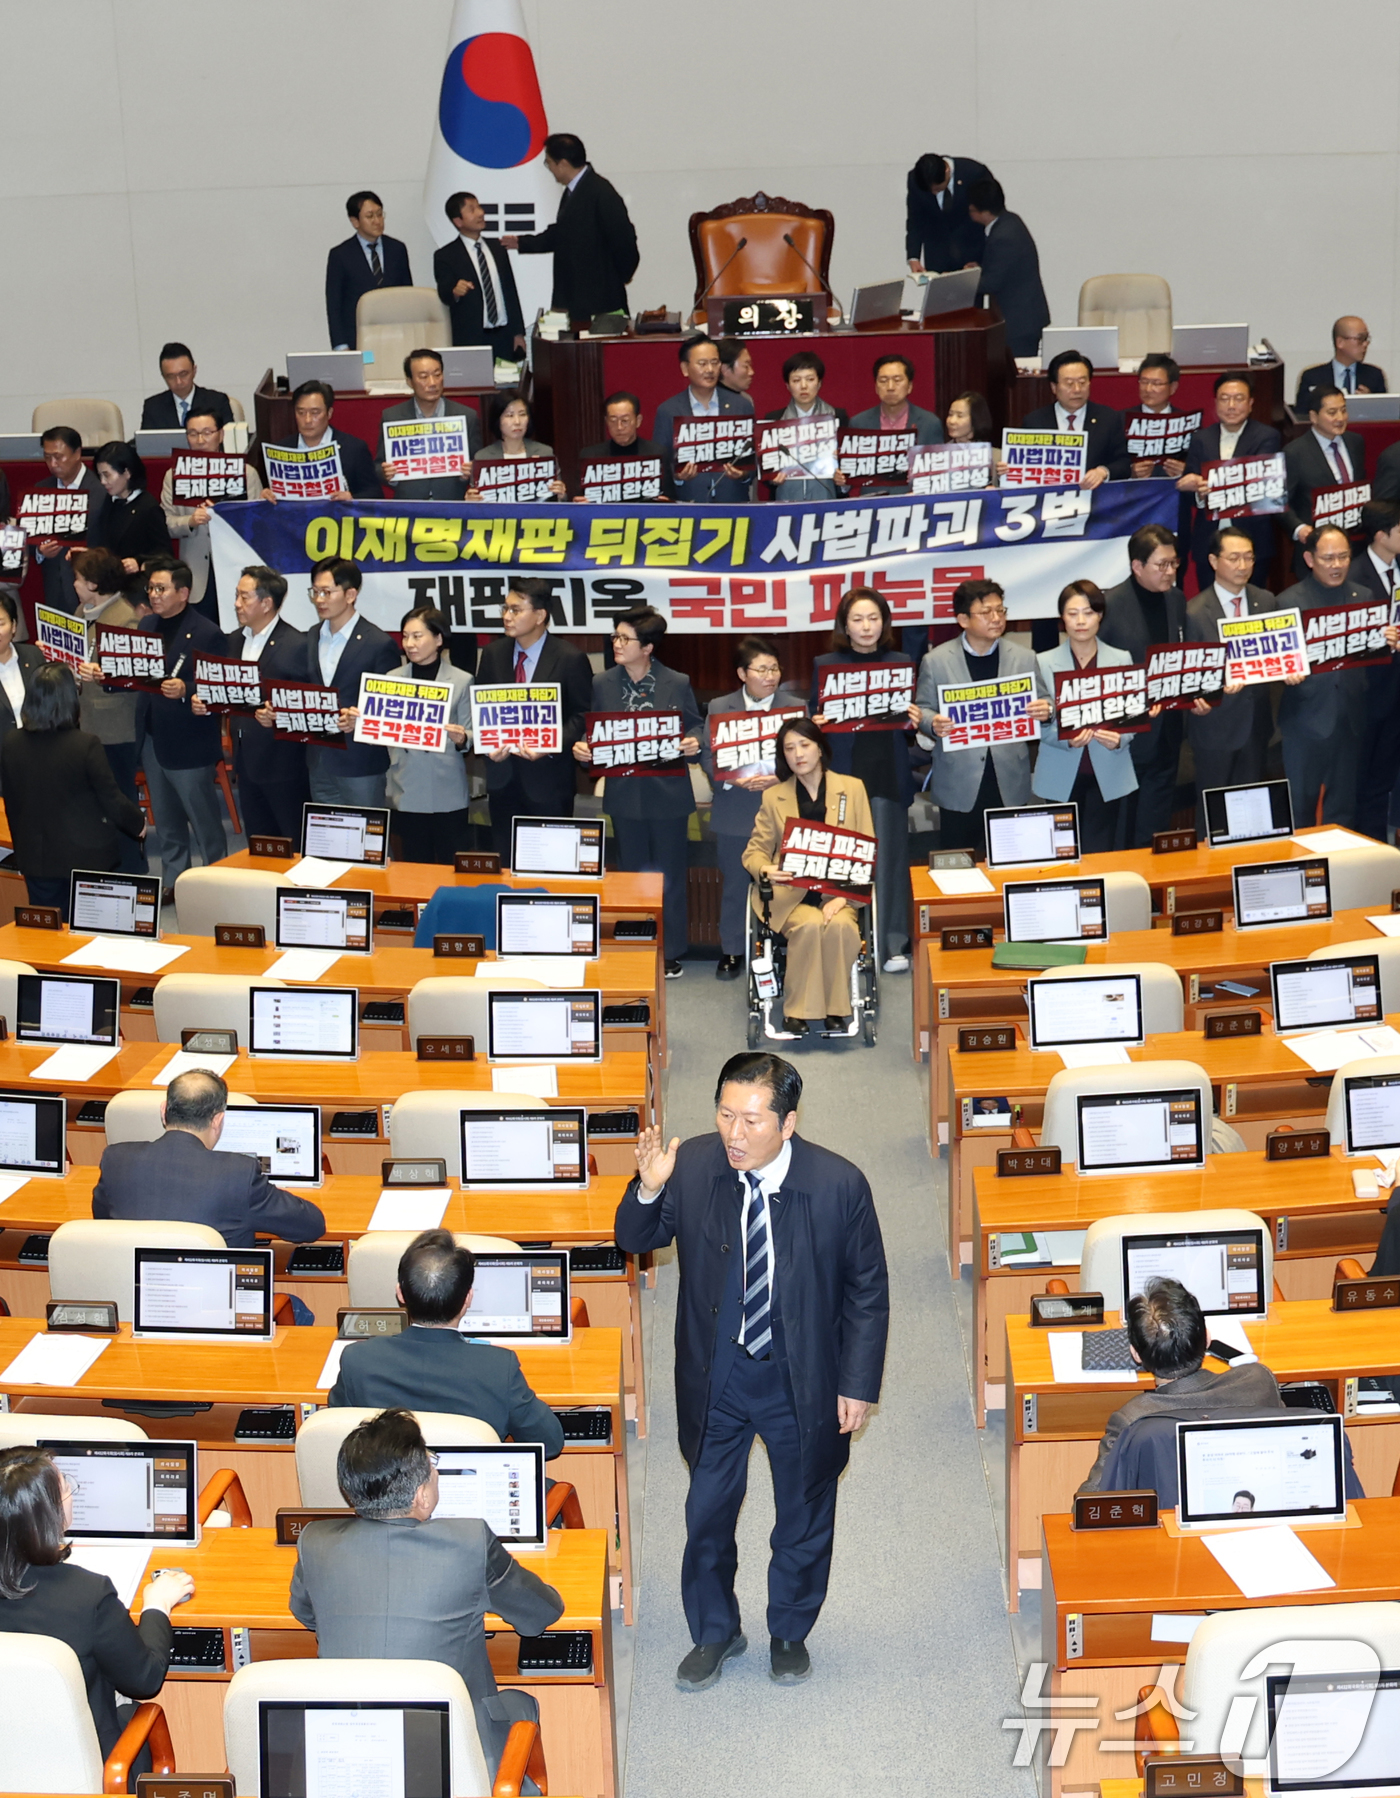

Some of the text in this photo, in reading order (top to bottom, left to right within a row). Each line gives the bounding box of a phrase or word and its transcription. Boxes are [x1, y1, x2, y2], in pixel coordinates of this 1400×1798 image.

[1344, 506, 1363, 529] 완
[304, 489, 1093, 567] 이재명재판 뒤집기 사법파괴 3법
[668, 577, 788, 628] 국민
[1347, 1289, 1395, 1302] 유동수
[1088, 1504, 1145, 1520] 김준혁
[1160, 1771, 1227, 1787] 고민정
